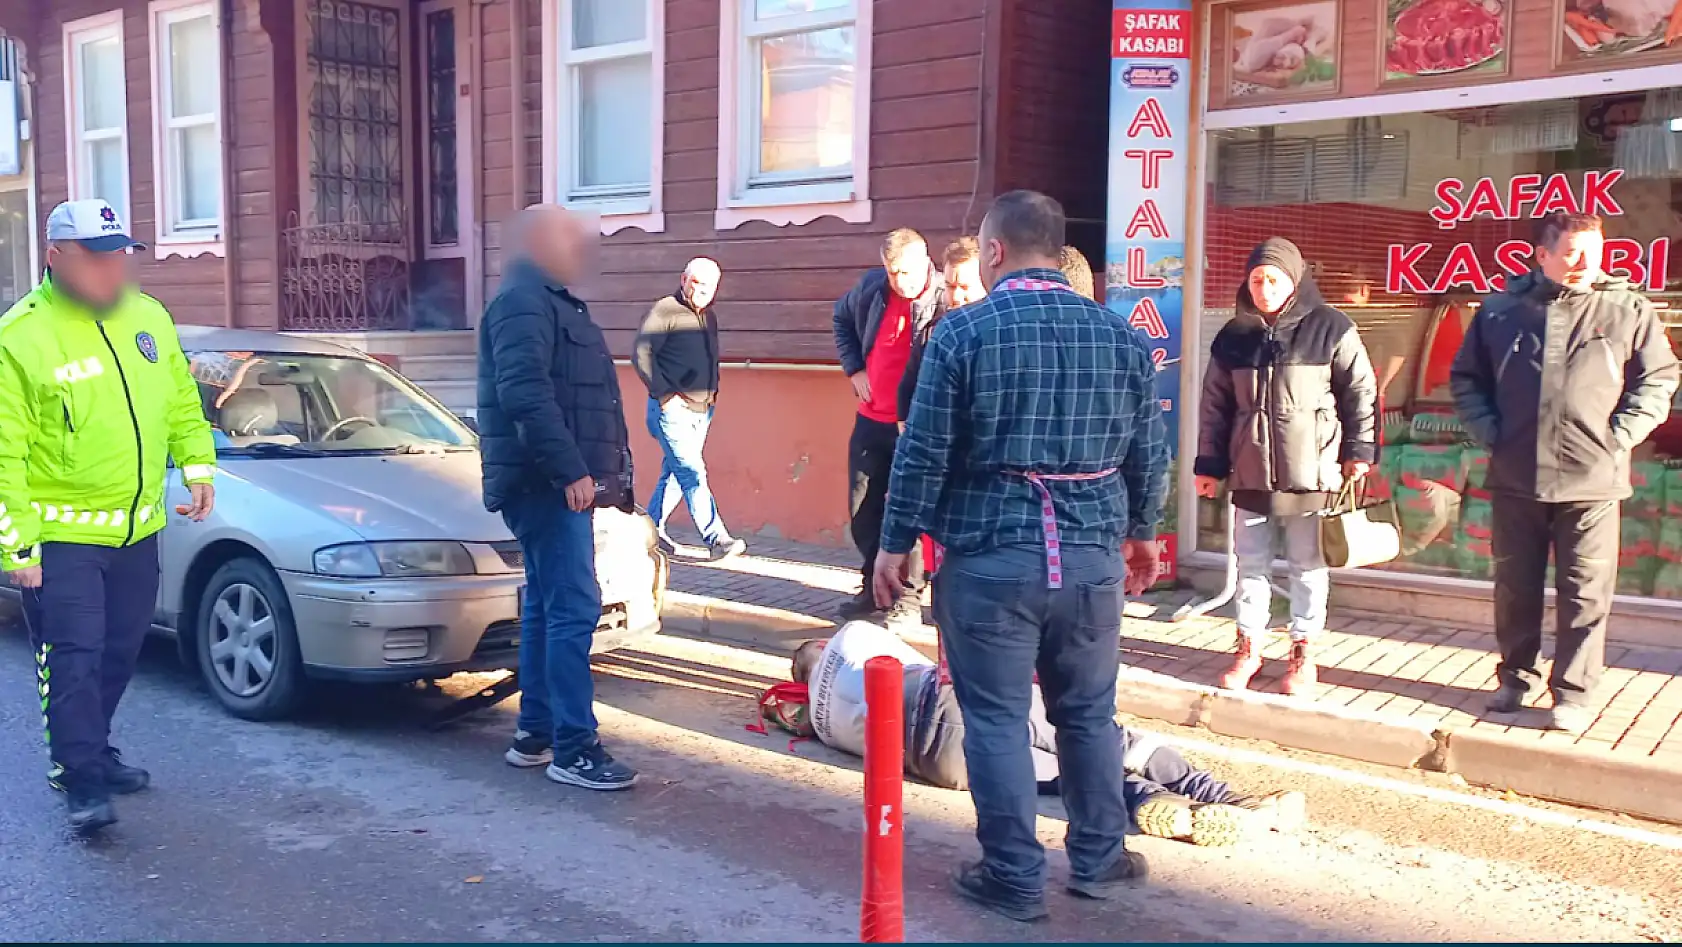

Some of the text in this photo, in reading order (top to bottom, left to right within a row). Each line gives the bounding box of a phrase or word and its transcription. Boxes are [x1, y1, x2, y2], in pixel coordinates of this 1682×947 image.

[1124, 13, 1180, 33] ŞAFAK
[1119, 36, 1184, 53] KASABI
[1430, 169, 1625, 230] ŞAFAK
[1386, 237, 1669, 294] KASBI
